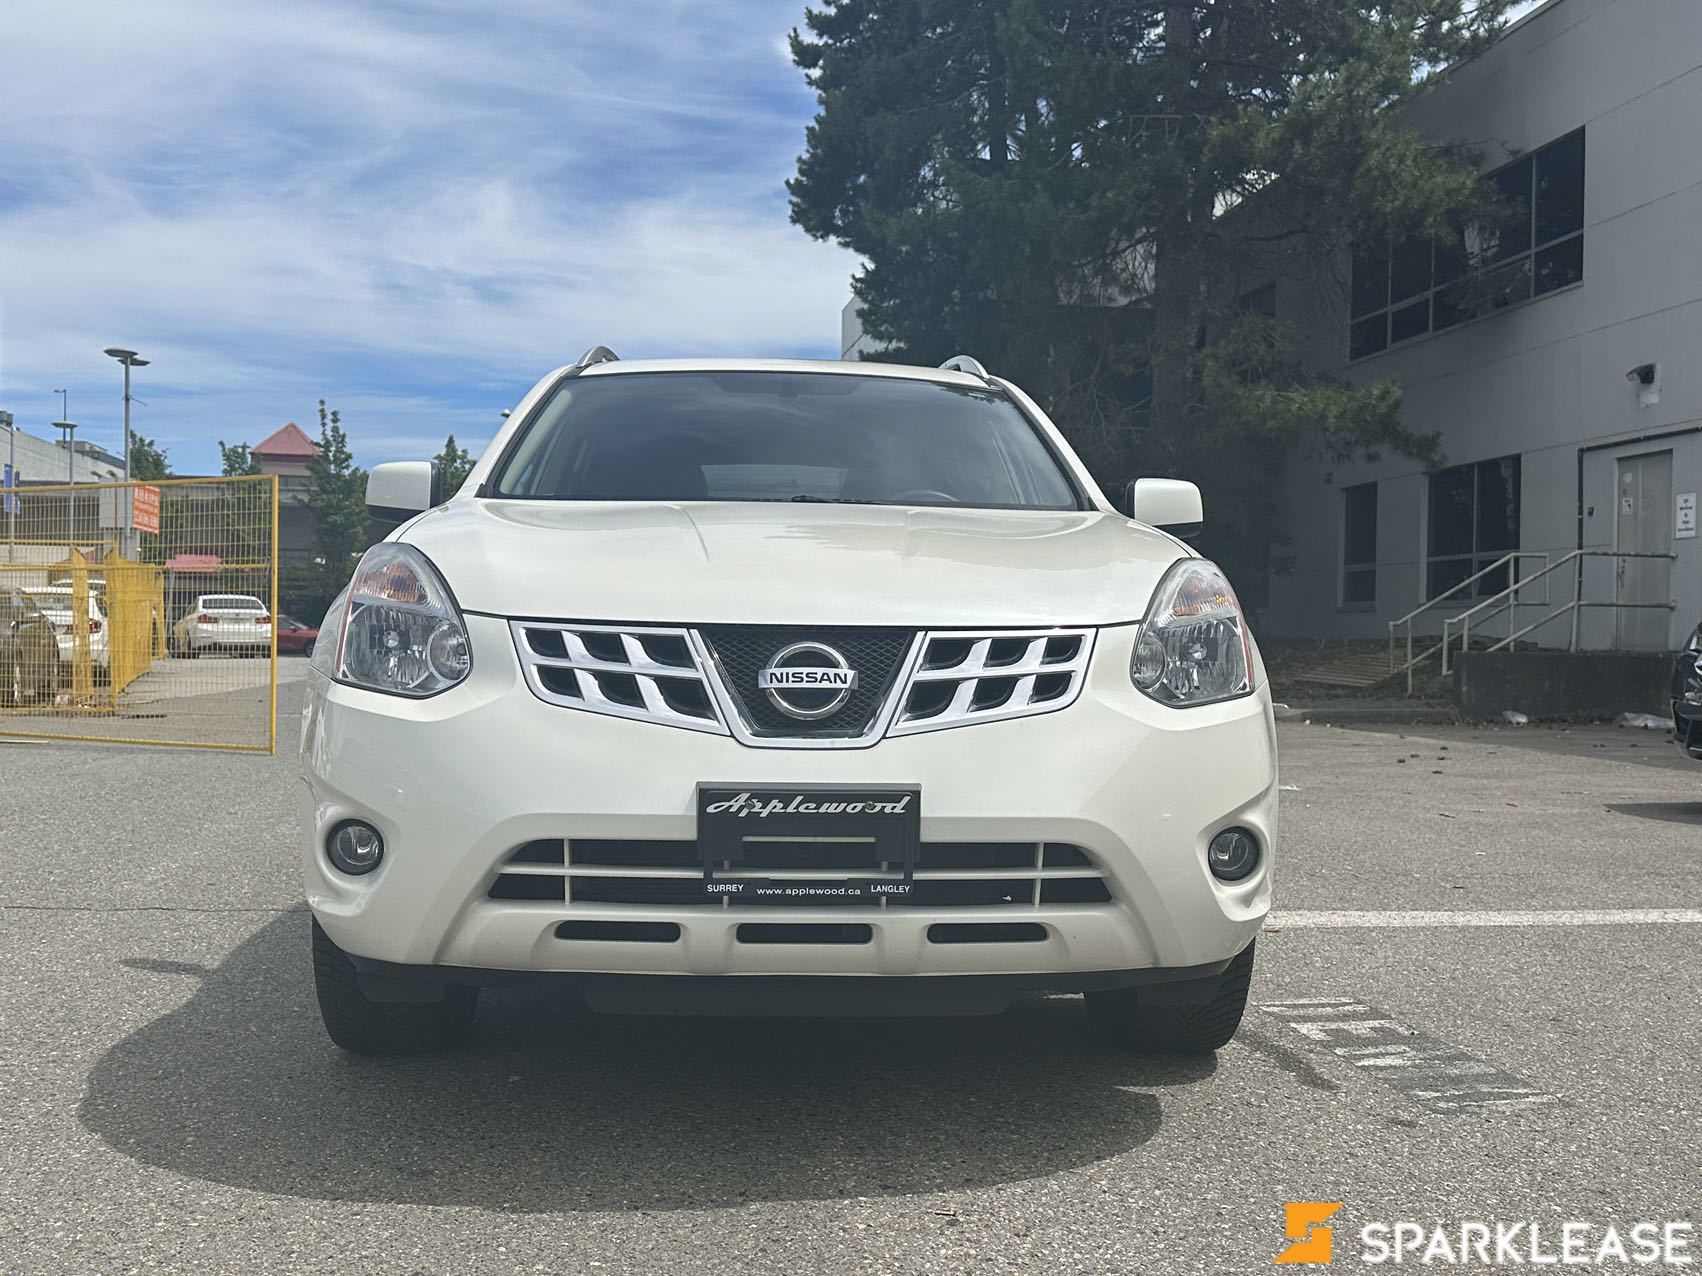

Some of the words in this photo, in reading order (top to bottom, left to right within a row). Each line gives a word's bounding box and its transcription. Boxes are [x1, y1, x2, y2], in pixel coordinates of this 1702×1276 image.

[769, 672, 847, 684] NISSAN
[706, 793, 911, 817] Applewood
[707, 884, 744, 892] SURREY
[757, 887, 861, 896] www.applewood.ca
[871, 884, 910, 893] LANGLEY
